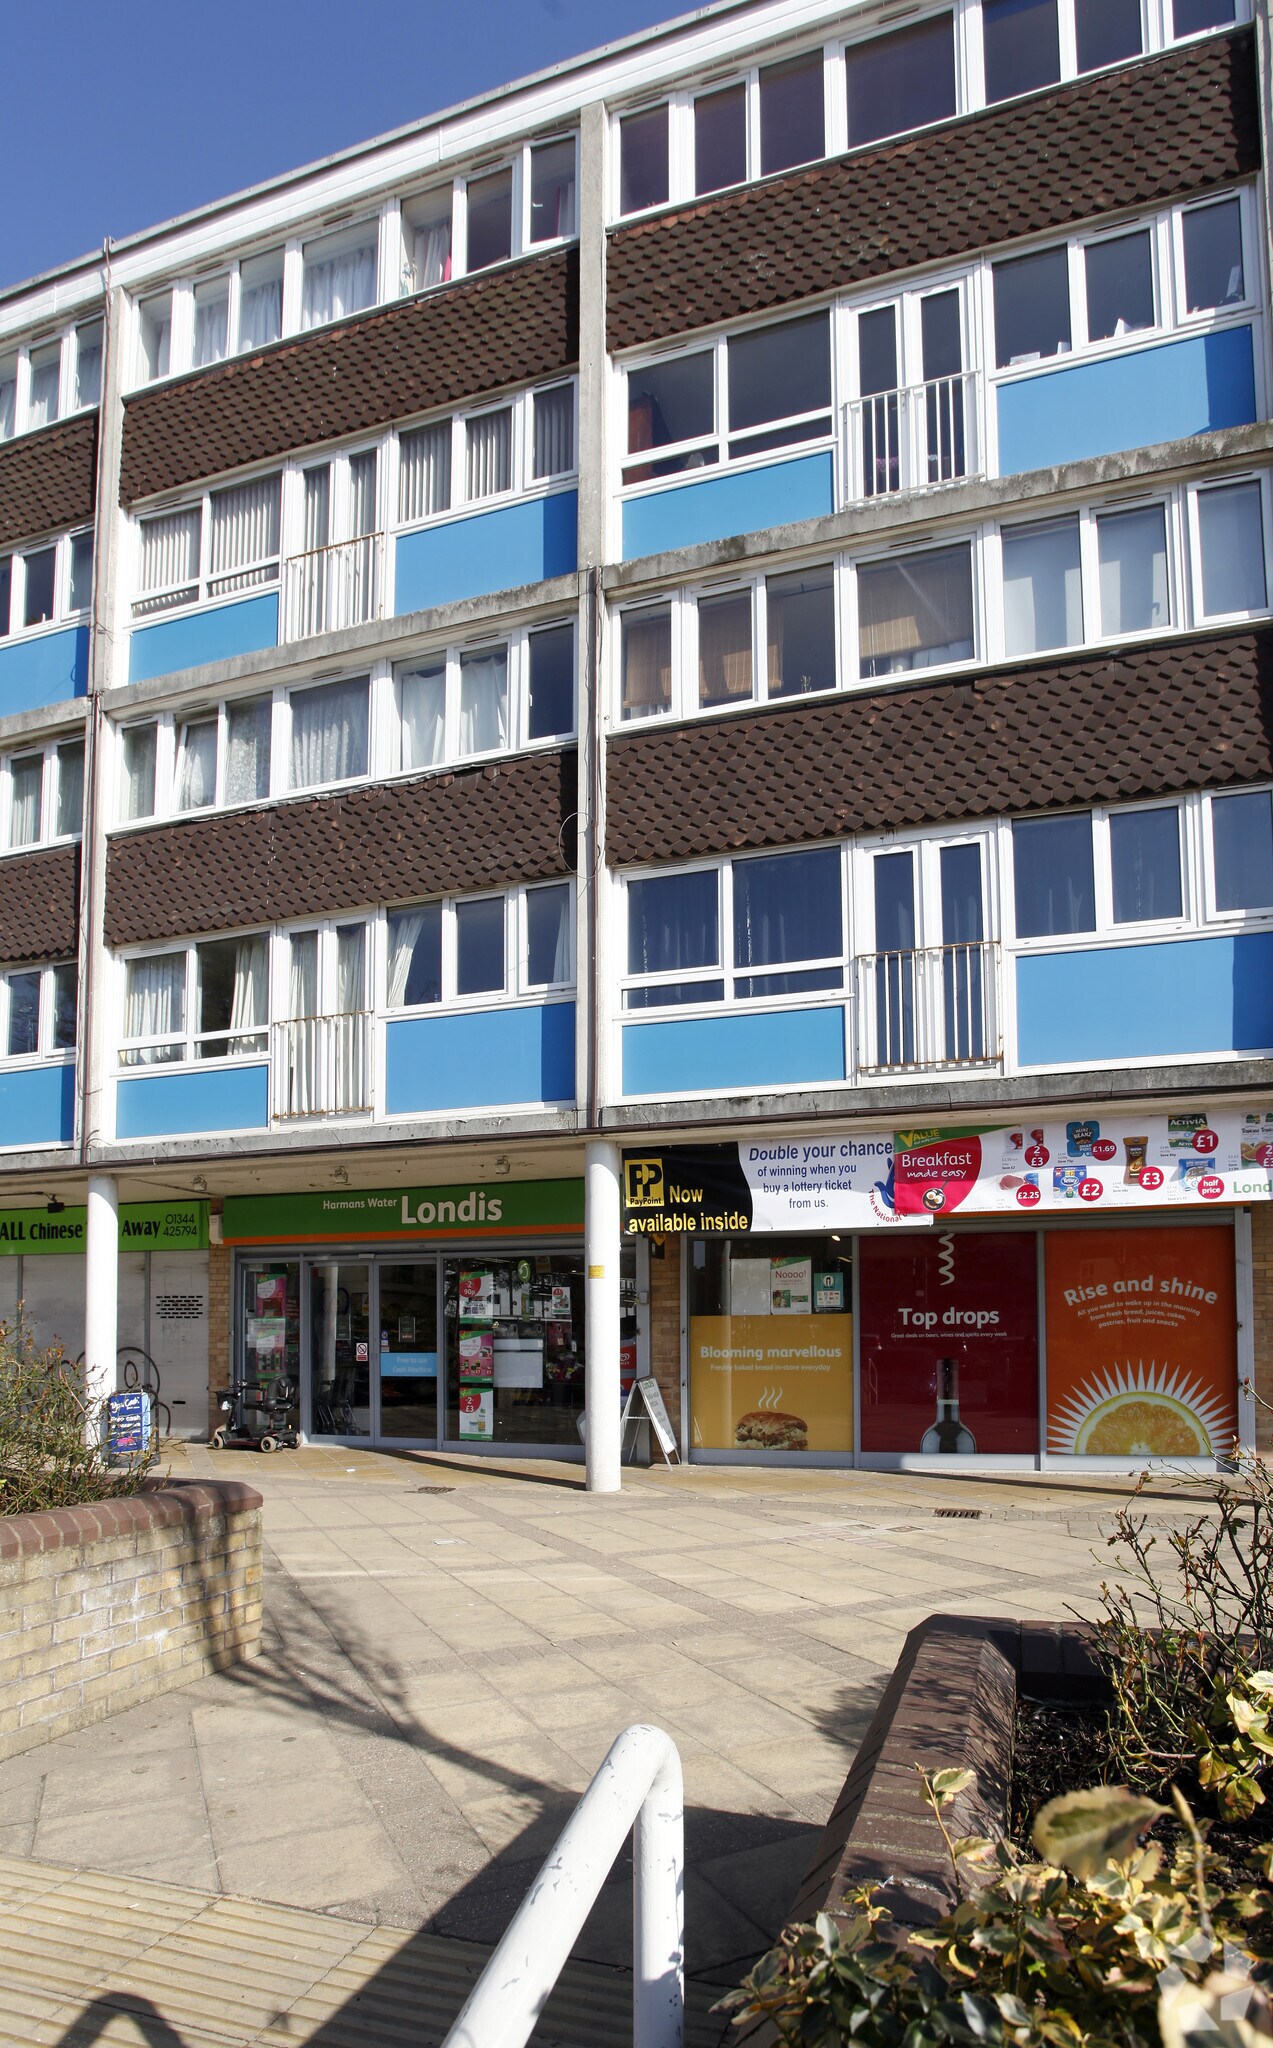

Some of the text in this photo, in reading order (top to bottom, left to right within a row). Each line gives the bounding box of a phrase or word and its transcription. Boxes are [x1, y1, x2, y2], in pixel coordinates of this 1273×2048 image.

[1170, 1118, 1206, 1126] ACTIVIA
[900, 1128, 940, 1147] VALUE
[1196, 1135, 1214, 1148] £1
[749, 1144, 798, 1161] Double
[803, 1144, 836, 1163] your
[1034, 1145, 1041, 1154] 2
[1092, 1145, 1115, 1153] £1.69
[1265, 1144, 1273, 1155] 2
[902, 1152, 972, 1167] Breakfast
[1030, 1156, 1043, 1166] £3
[757, 1163, 857, 1178] of winning when you
[907, 1169, 967, 1179] made easy
[1142, 1172, 1160, 1185] £3
[1203, 1179, 1219, 1187] half
[763, 1179, 852, 1195] buy a lottery ticket
[1082, 1183, 1100, 1196] £2
[1202, 1187, 1221, 1195] price
[669, 1185, 704, 1203] Now
[868, 1188, 876, 1206] The
[1017, 1191, 1039, 1199] £2.25
[323, 1198, 397, 1210] Harmans Water
[401, 1191, 503, 1224] Londis
[630, 1197, 662, 1206] PayPoint
[789, 1198, 829, 1209] from us.
[165, 1213, 195, 1225] 01344
[629, 1211, 748, 1233] available inside
[0, 1221, 26, 1241] ALL
[30, 1222, 83, 1240] Chinese
[122, 1219, 160, 1239] Away
[163, 1225, 197, 1237] 425794
[775, 1270, 807, 1279] Noooo!
[1063, 1275, 1218, 1306] Rise and shine
[1077, 1309, 1086, 1317] All
[1086, 1306, 1099, 1314] you
[1100, 1302, 1116, 1311] need
[1143, 1300, 1152, 1308] up
[1161, 1301, 1172, 1309] the
[1173, 1303, 1201, 1316] morning
[898, 1306, 1000, 1330] Top drops
[1090, 1313, 1105, 1321] from
[1106, 1310, 1123, 1318] fresh
[1145, 1309, 1166, 1317] juices,
[1167, 1311, 1187, 1321] cakes,
[1098, 1318, 1126, 1329] pastries,
[1156, 1318, 1178, 1327] snacks
[700, 1345, 842, 1360] Blooming marvellous
[711, 1364, 732, 1372] Freshly
[801, 1364, 831, 1372] everyday
